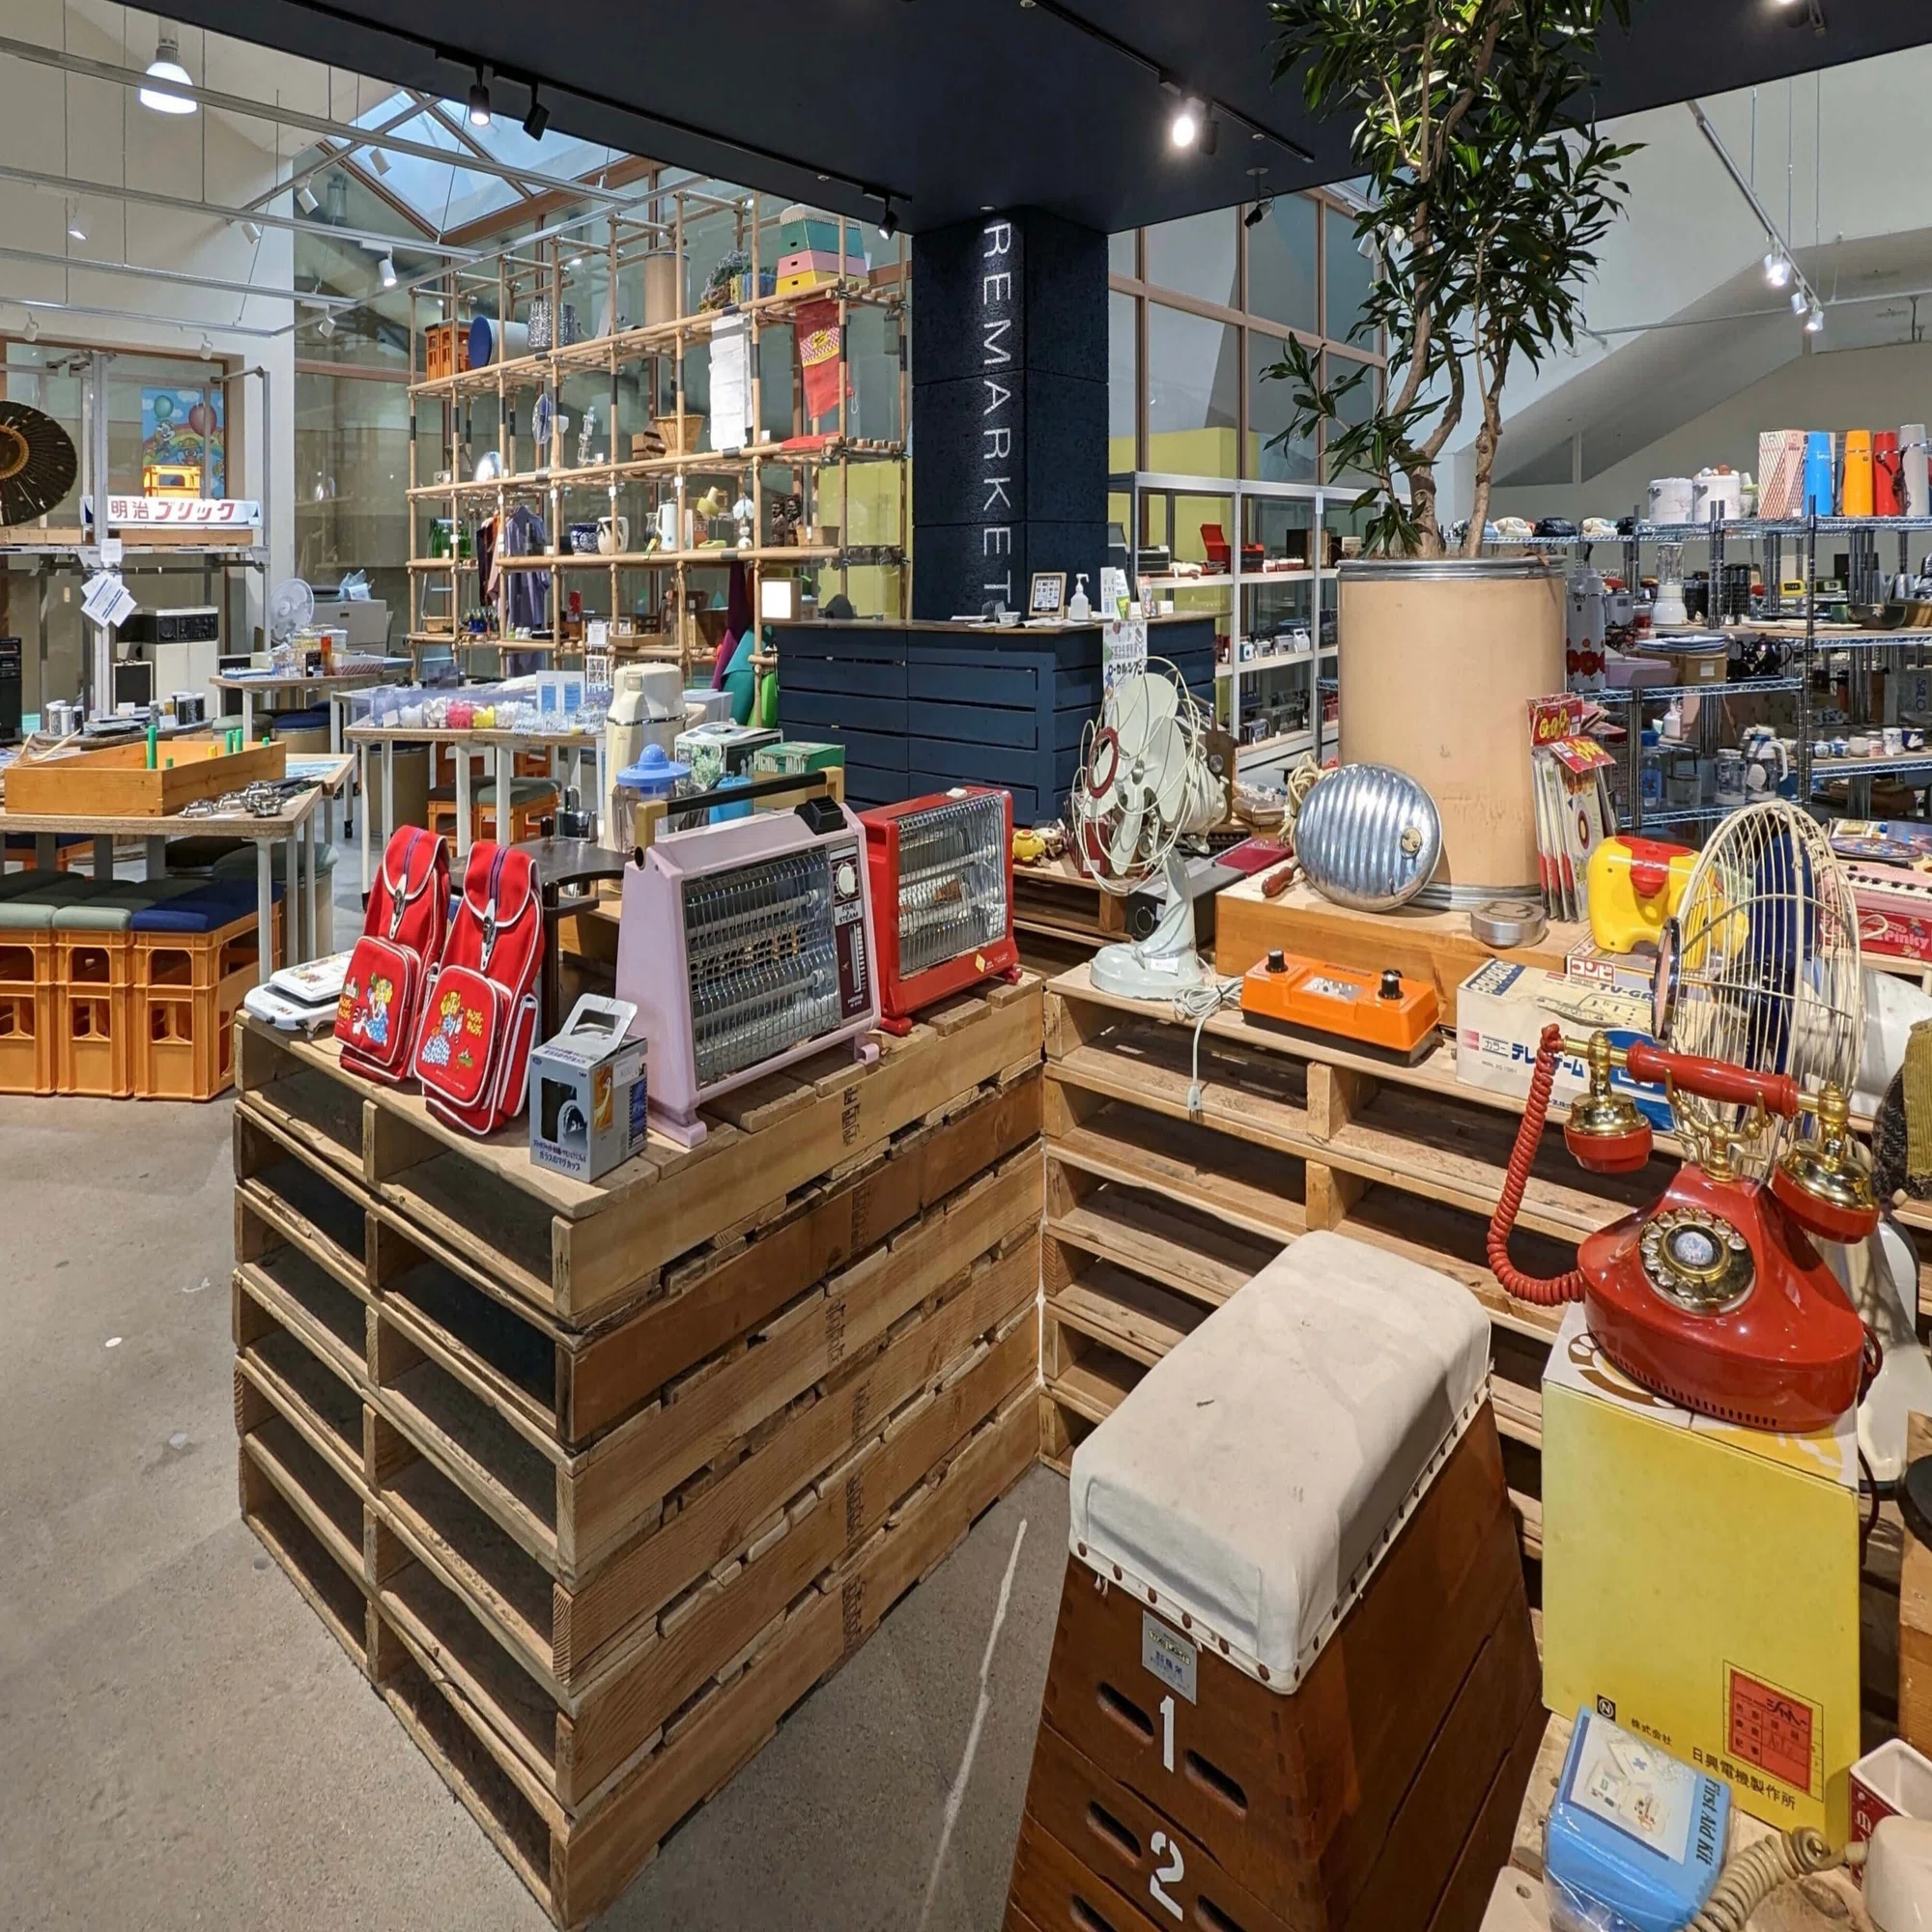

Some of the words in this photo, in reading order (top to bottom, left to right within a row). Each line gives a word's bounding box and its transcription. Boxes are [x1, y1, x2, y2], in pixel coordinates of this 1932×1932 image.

[982, 222, 1011, 605] REMARKET
[110, 500, 235, 521] 明治ブリック
[838, 911, 859, 924] STEAM
[1884, 929, 1930, 950] Pinky
[1570, 958, 1613, 983] コンビ
[1600, 982, 1656, 1001] TV-GA
[1484, 1039, 1506, 1052] カラー
[1511, 1042, 1585, 1079] テレゲーム
[1160, 1694, 1175, 1774] 1
[1631, 1718, 1672, 1747] 株式会社
[1692, 1746, 1796, 1811] 日興電機製作所
[1702, 1777, 1720, 1813] First
[1699, 1810, 1717, 1841] Aid
[1695, 1838, 1714, 1866] Kit
[1150, 1832, 1184, 1921] 2
